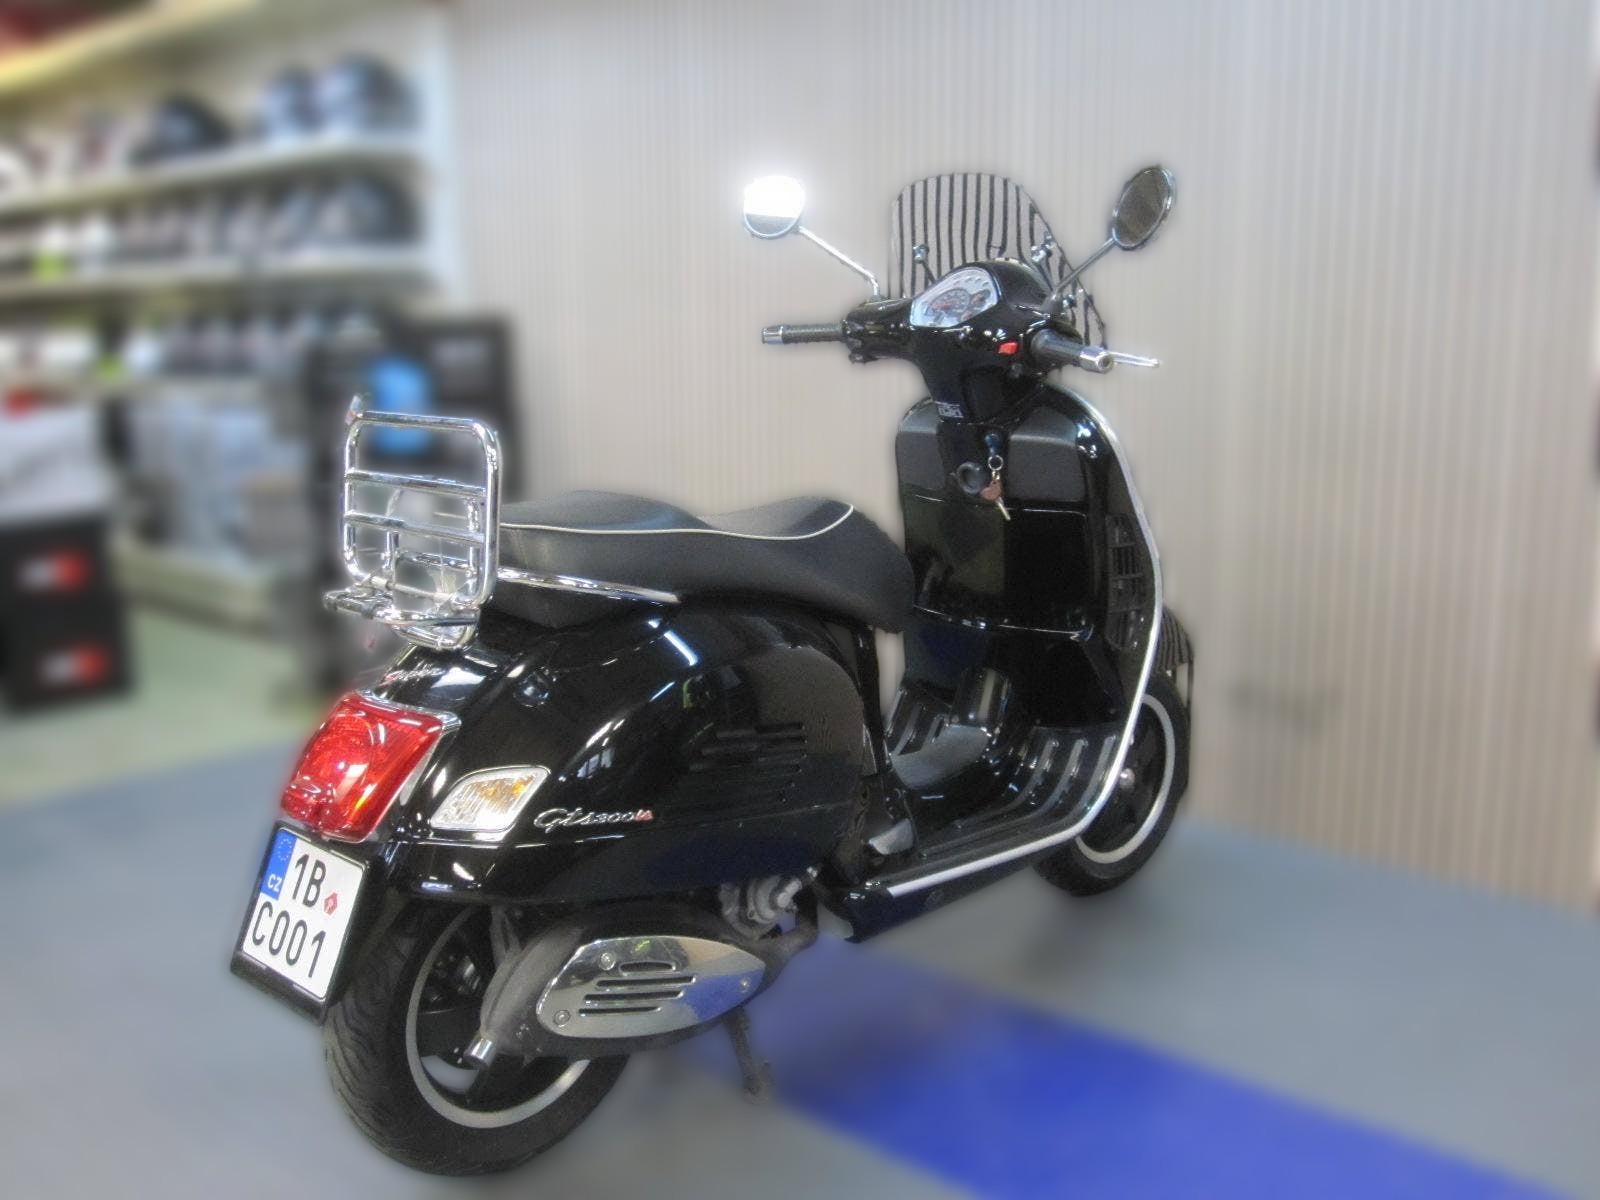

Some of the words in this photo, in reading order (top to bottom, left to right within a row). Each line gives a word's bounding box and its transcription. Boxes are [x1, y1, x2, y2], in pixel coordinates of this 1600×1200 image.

[267, 873, 282, 892] CZ
[292, 853, 327, 908] 1B
[252, 901, 326, 978] C001
